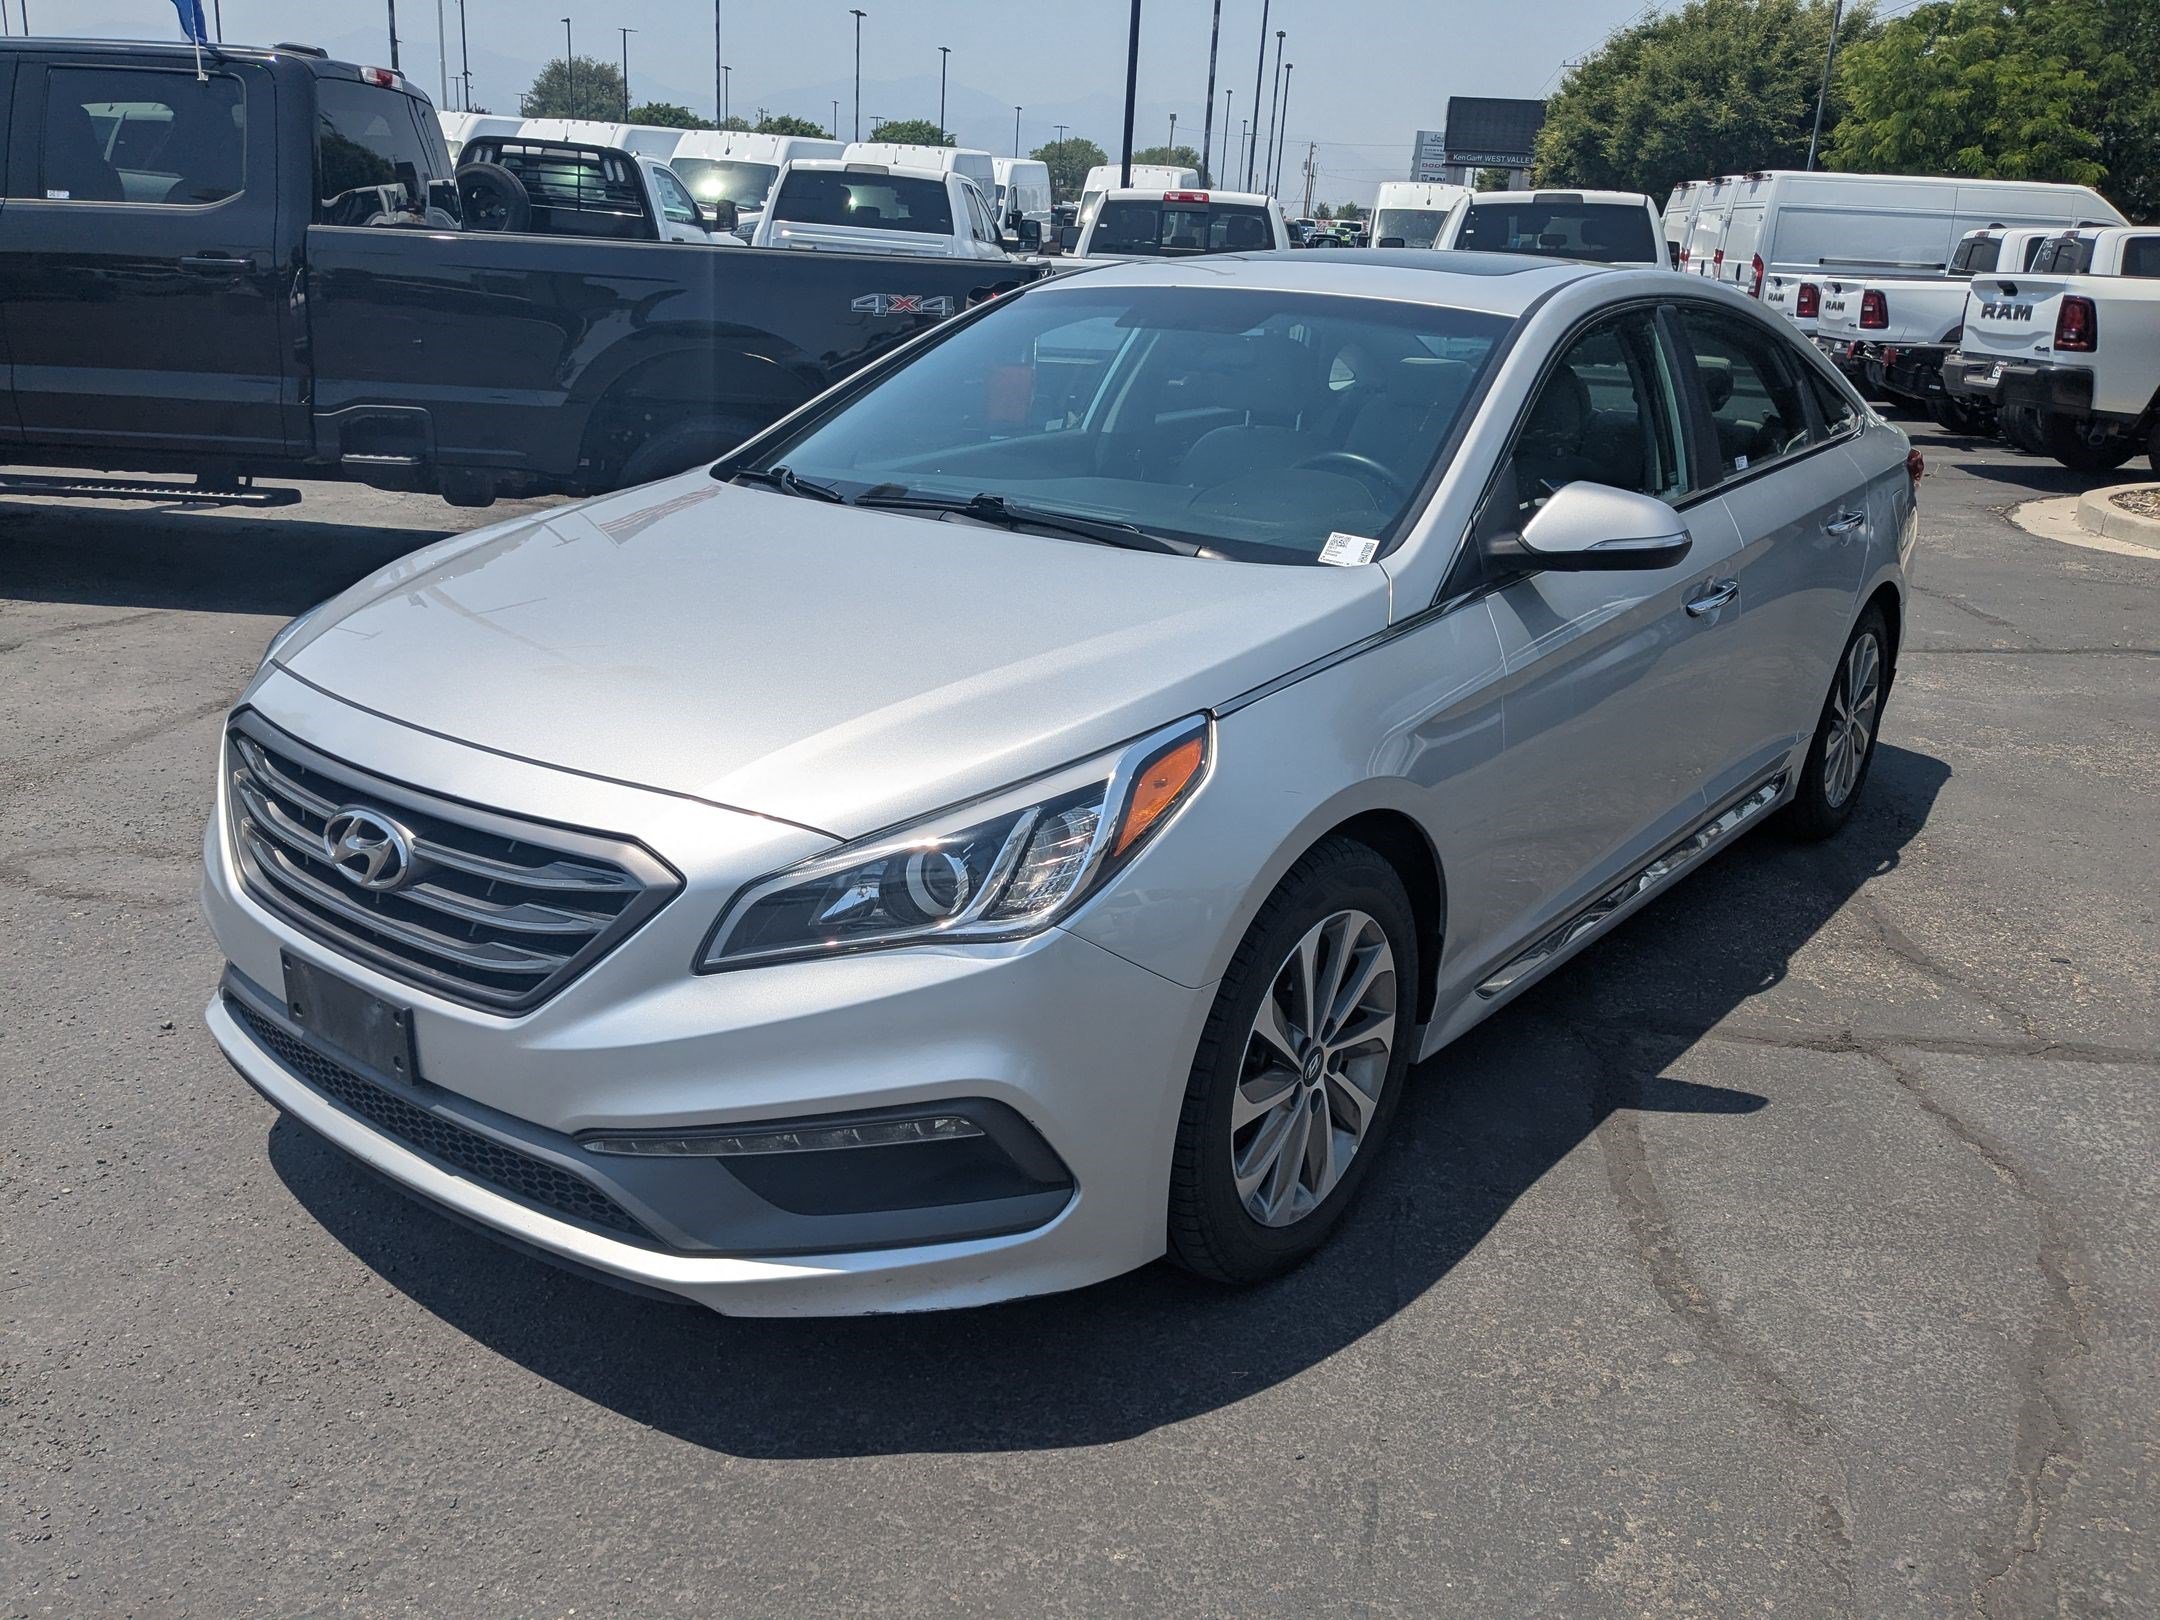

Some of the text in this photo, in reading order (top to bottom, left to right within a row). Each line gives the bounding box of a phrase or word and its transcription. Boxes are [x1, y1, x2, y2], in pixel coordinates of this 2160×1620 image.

[1453, 153, 1466, 161] Ken
[1485, 155, 1506, 163] WEST
[1507, 156, 1534, 164] VALLEY
[1768, 292, 1784, 302] RAM
[1825, 301, 1845, 312] RAM
[1981, 303, 2034, 322] RAM
